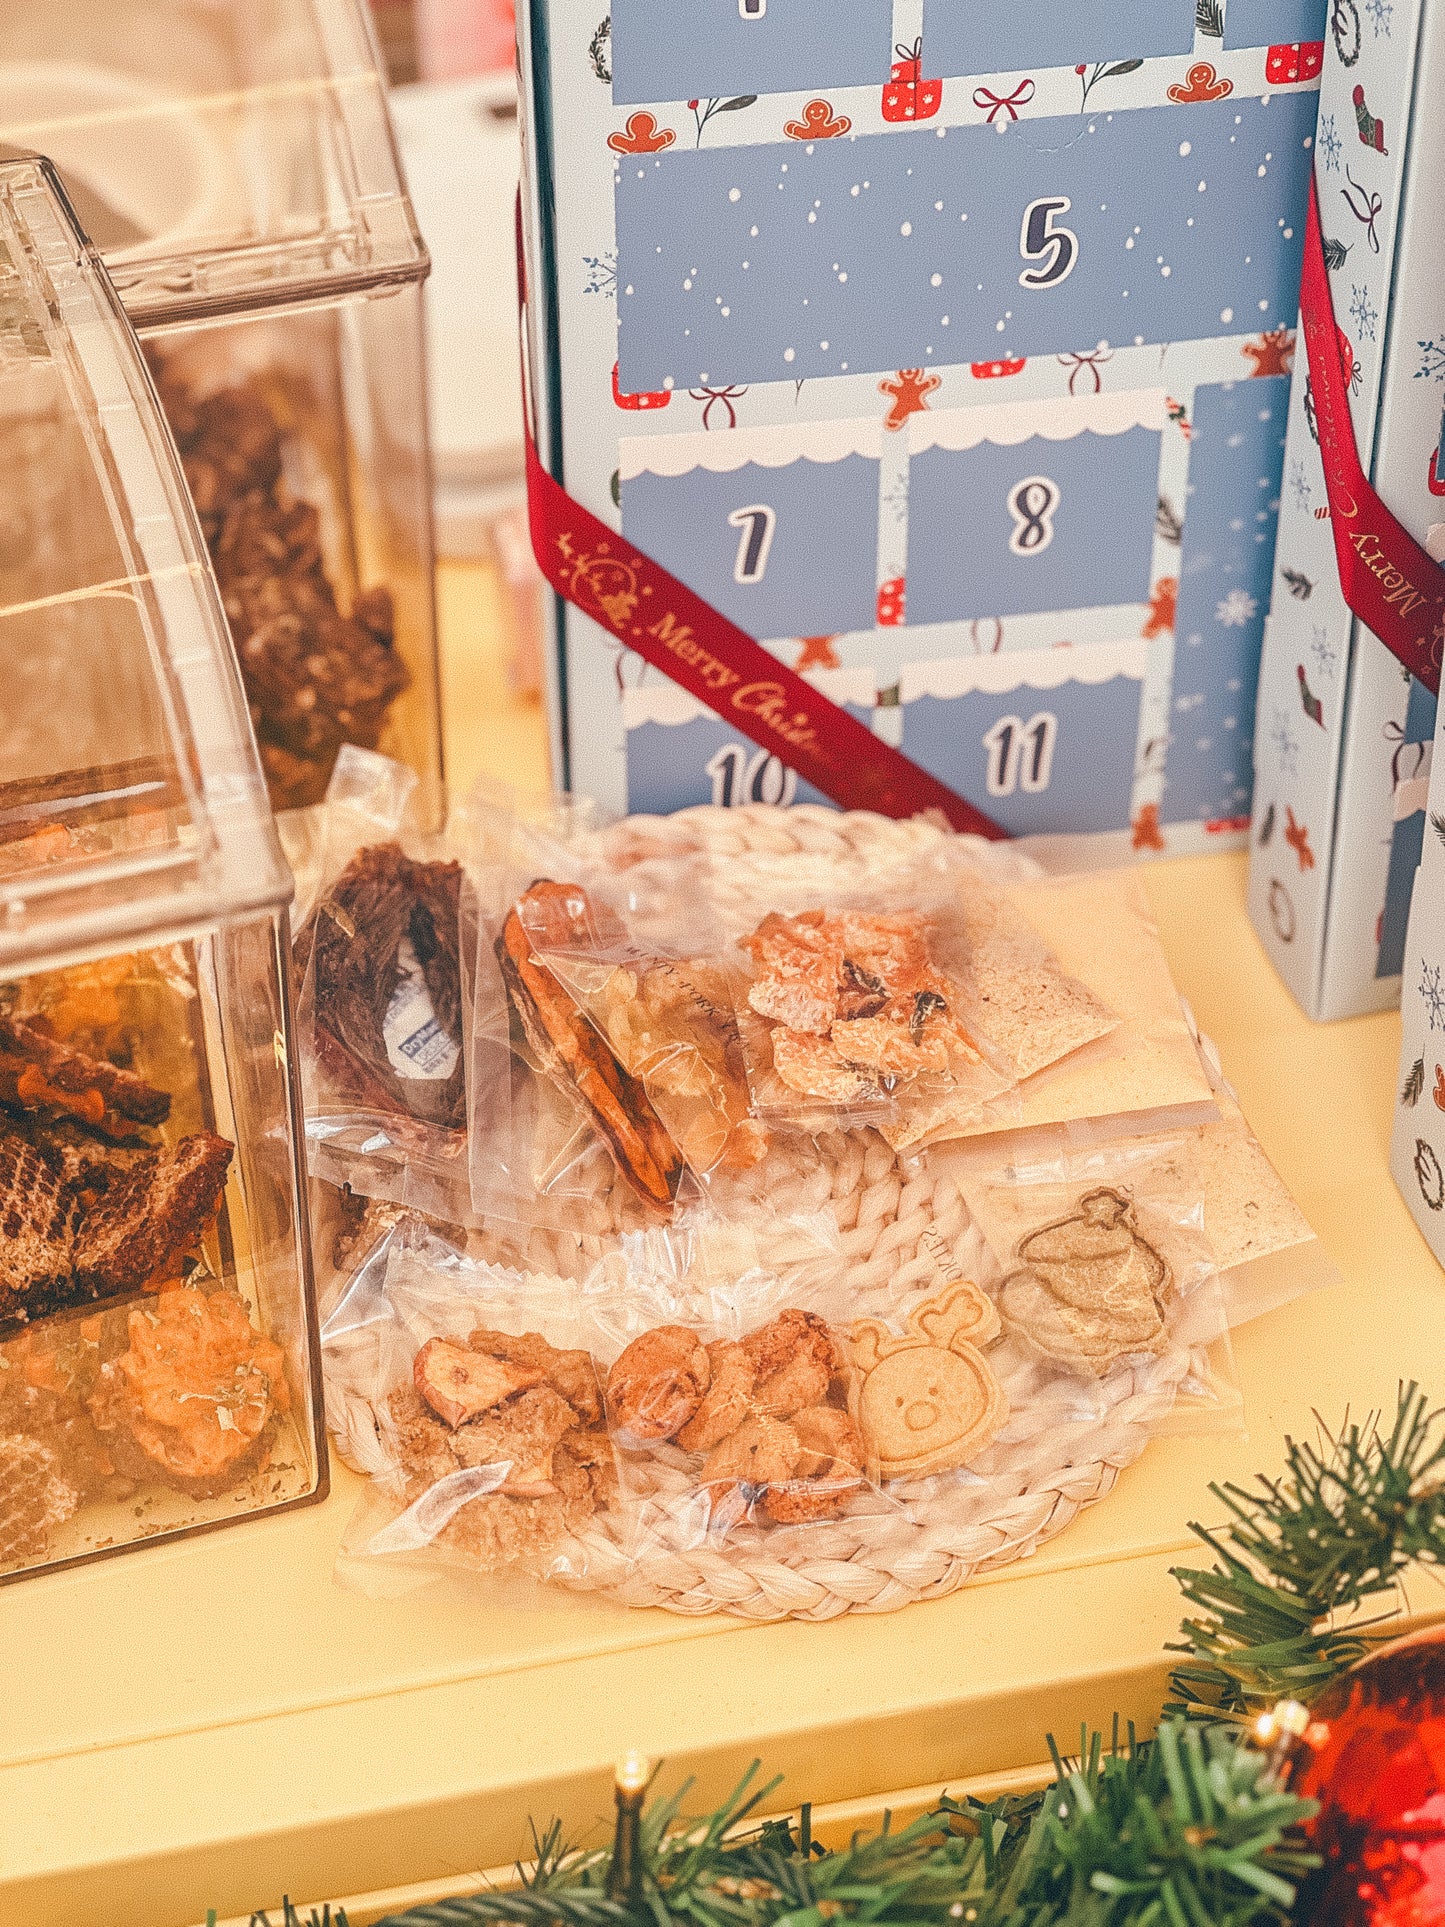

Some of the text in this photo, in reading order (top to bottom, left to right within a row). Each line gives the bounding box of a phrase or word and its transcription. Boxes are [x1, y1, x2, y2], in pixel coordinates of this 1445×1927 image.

[1019, 196, 1079, 290] 5
[1008, 475, 1061, 556] 8
[1349, 531, 1427, 618] Merry
[647, 611, 742, 689] Merry
[705, 743, 798, 807] 10
[984, 711, 1058, 796] 11
[680, 981, 720, 1017] PORK
